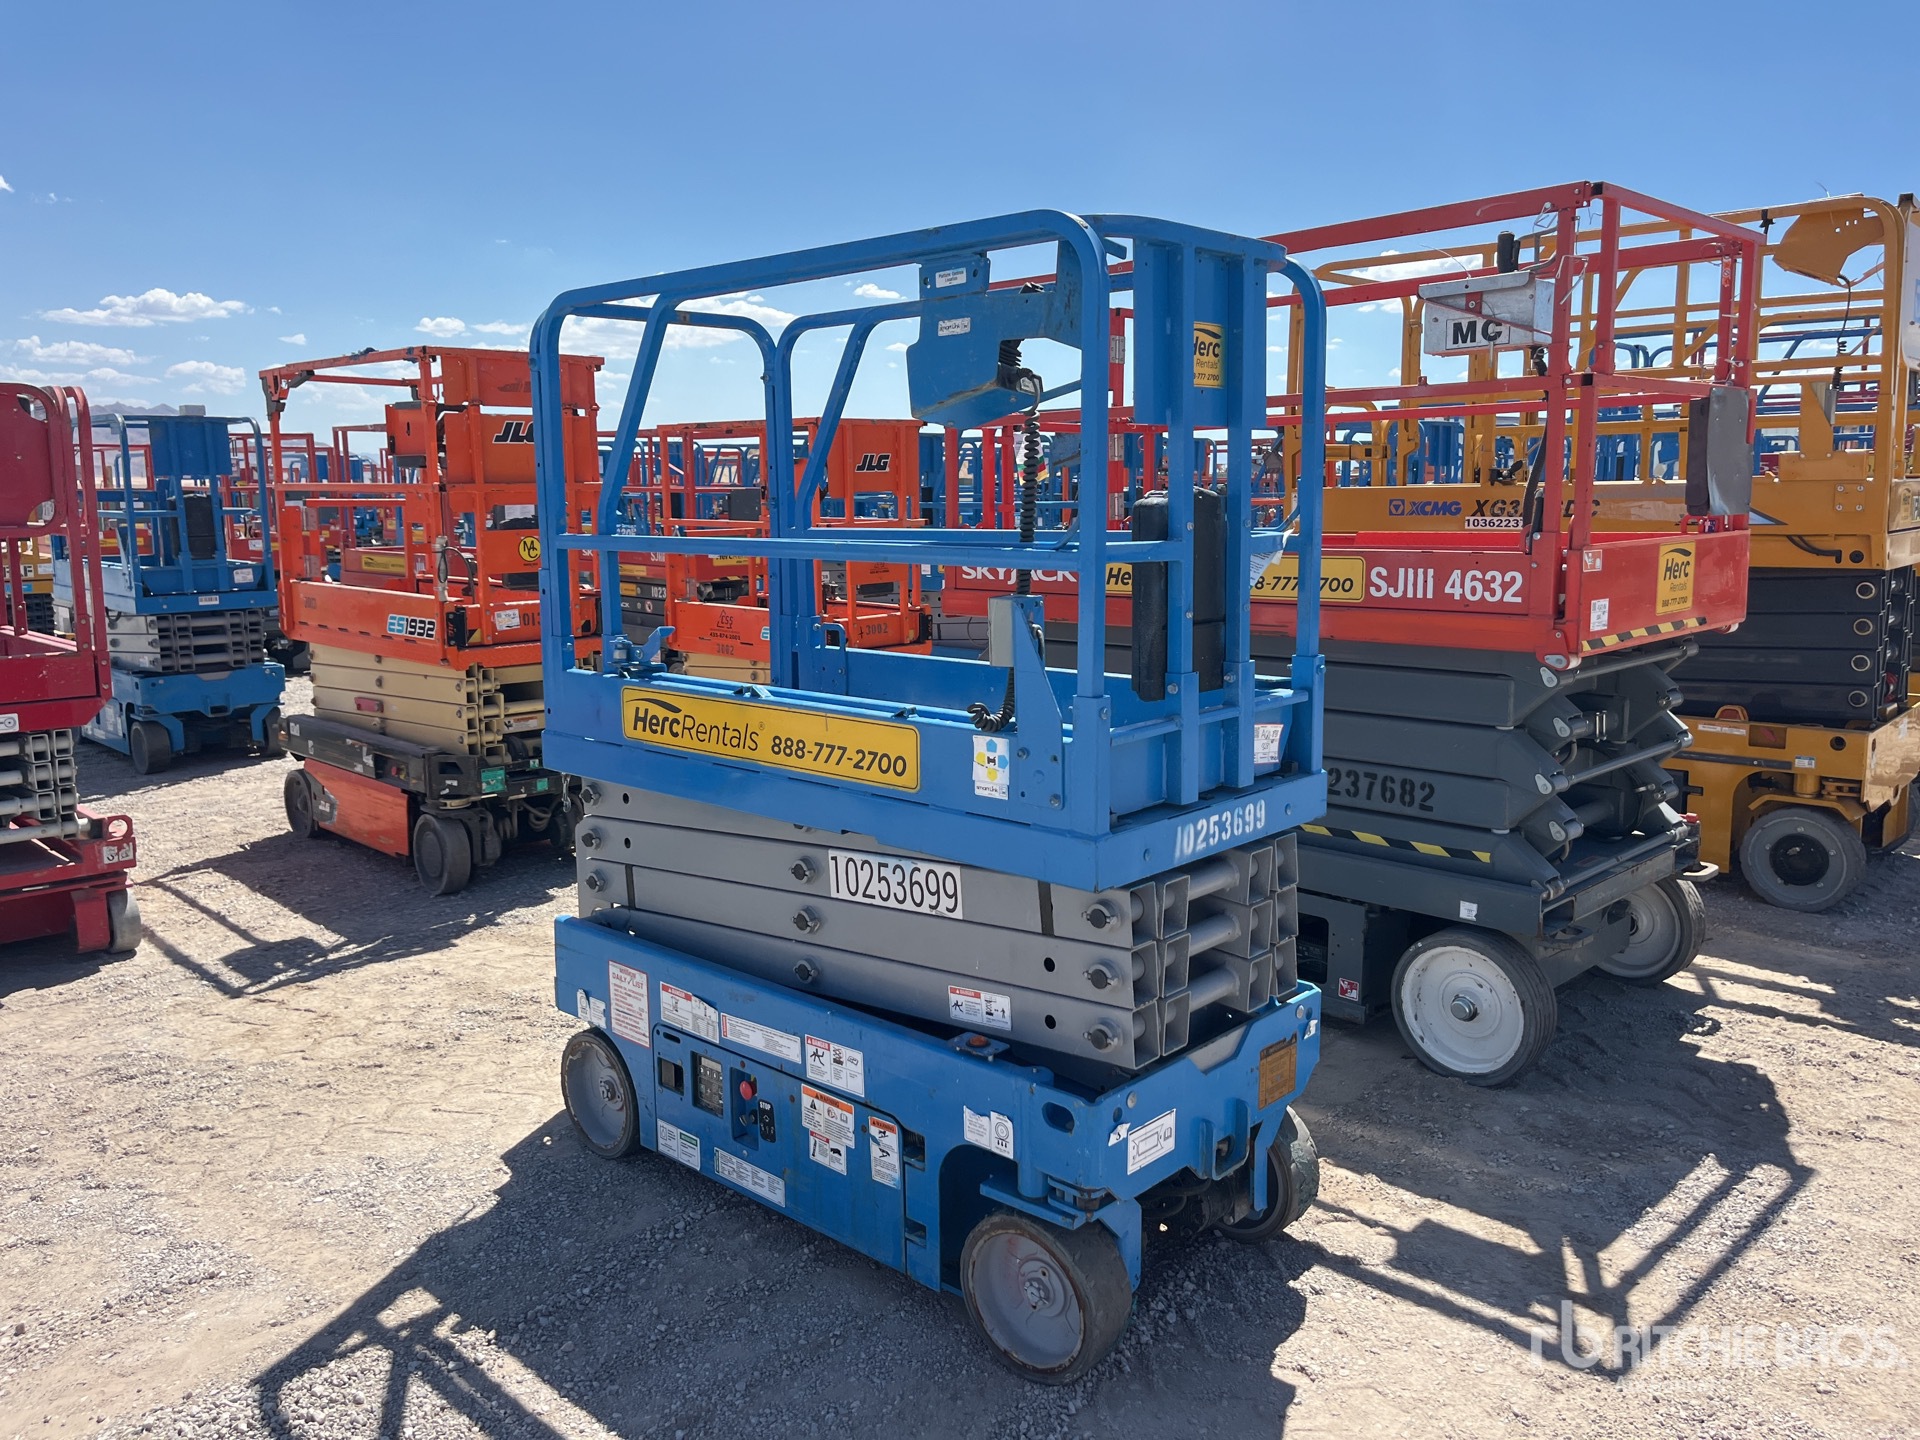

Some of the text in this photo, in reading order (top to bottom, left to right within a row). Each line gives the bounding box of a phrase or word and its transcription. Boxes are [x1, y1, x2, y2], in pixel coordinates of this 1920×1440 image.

[855, 453, 891, 473] JLG
[1405, 500, 1463, 517] XCMG
[1663, 557, 1691, 581] Herc
[1444, 568, 1523, 603] 4632
[387, 614, 436, 640] ES1932
[770, 734, 908, 778] 888-777-2700
[1174, 799, 1266, 863] 10253699
[830, 855, 959, 914] 10253699
[811, 1037, 830, 1050] DANGER
[760, 1101, 771, 1111] STOP
